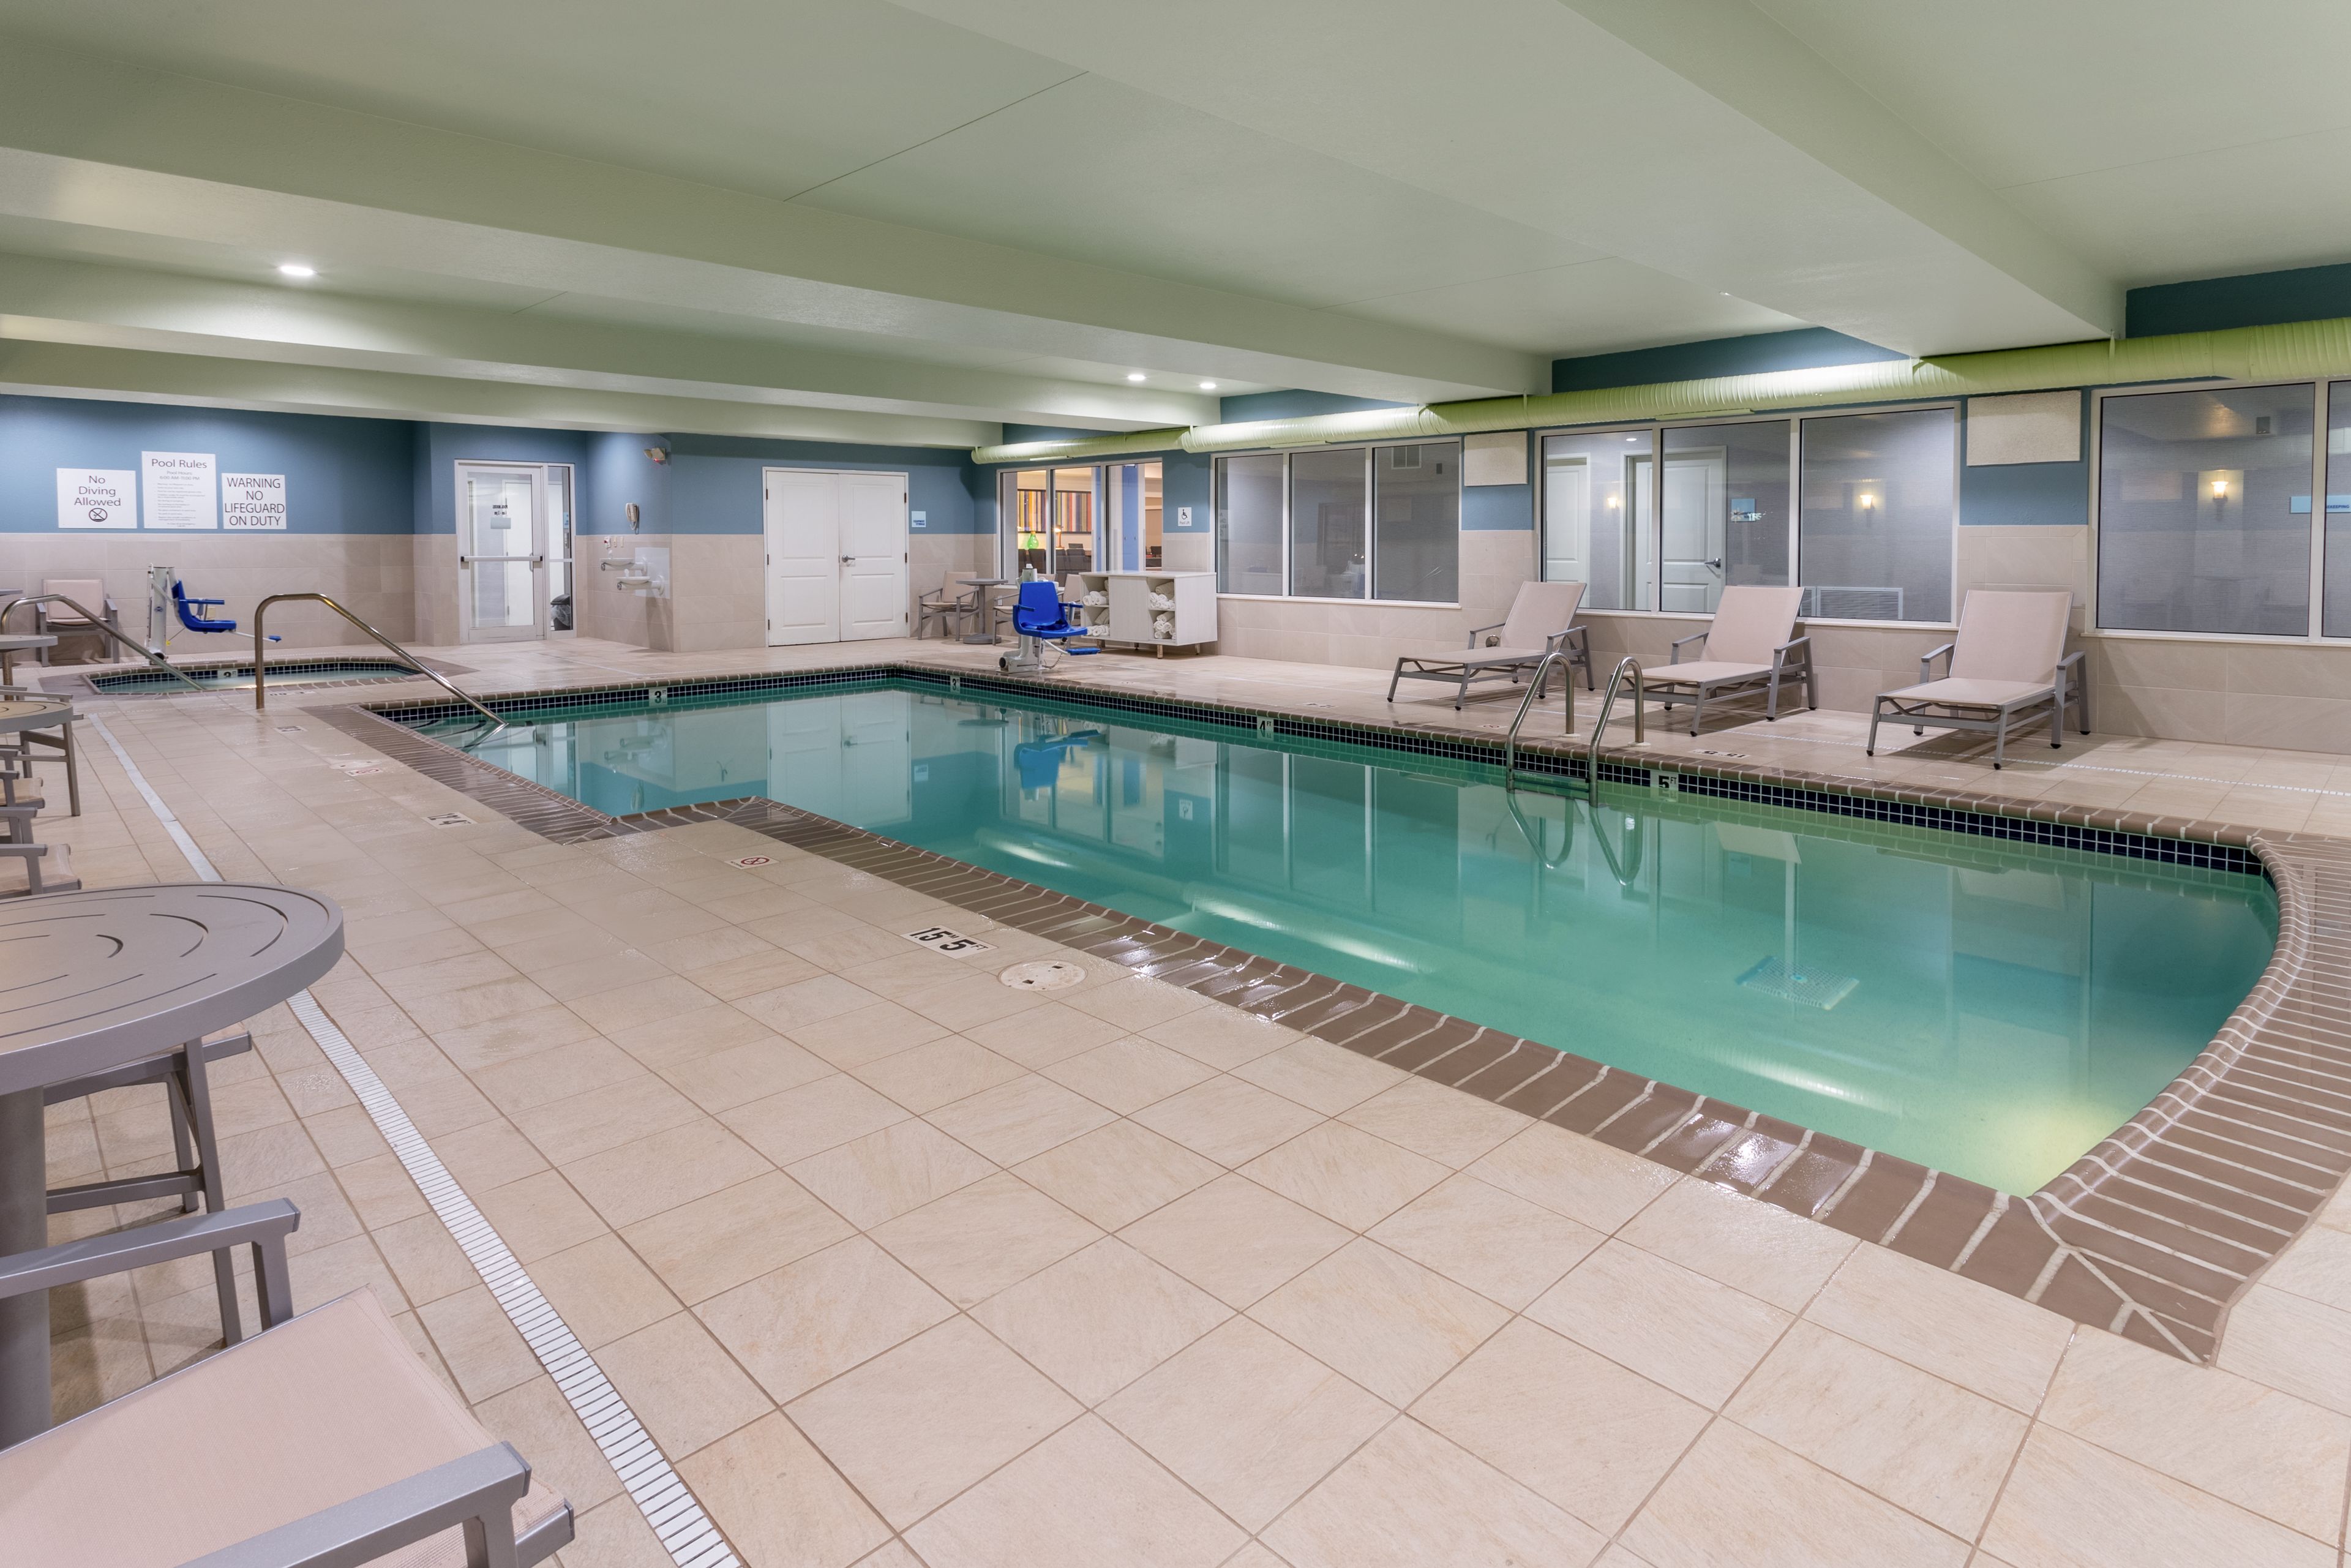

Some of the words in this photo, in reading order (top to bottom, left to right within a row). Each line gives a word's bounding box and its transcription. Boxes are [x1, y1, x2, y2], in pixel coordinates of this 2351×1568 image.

[152, 459, 175, 467] Pool
[179, 460, 207, 468] Rules
[89, 475, 105, 484] No
[227, 478, 281, 488] WARNING
[78, 486, 116, 497] Diving
[246, 490, 263, 501] NO
[74, 497, 121, 506] Allowed
[225, 503, 285, 513] LIFEGUARD
[229, 516, 247, 526] ON
[250, 516, 281, 526] DUTY
[1659, 775, 1670, 789] 5
[939, 939, 977, 951] 5
